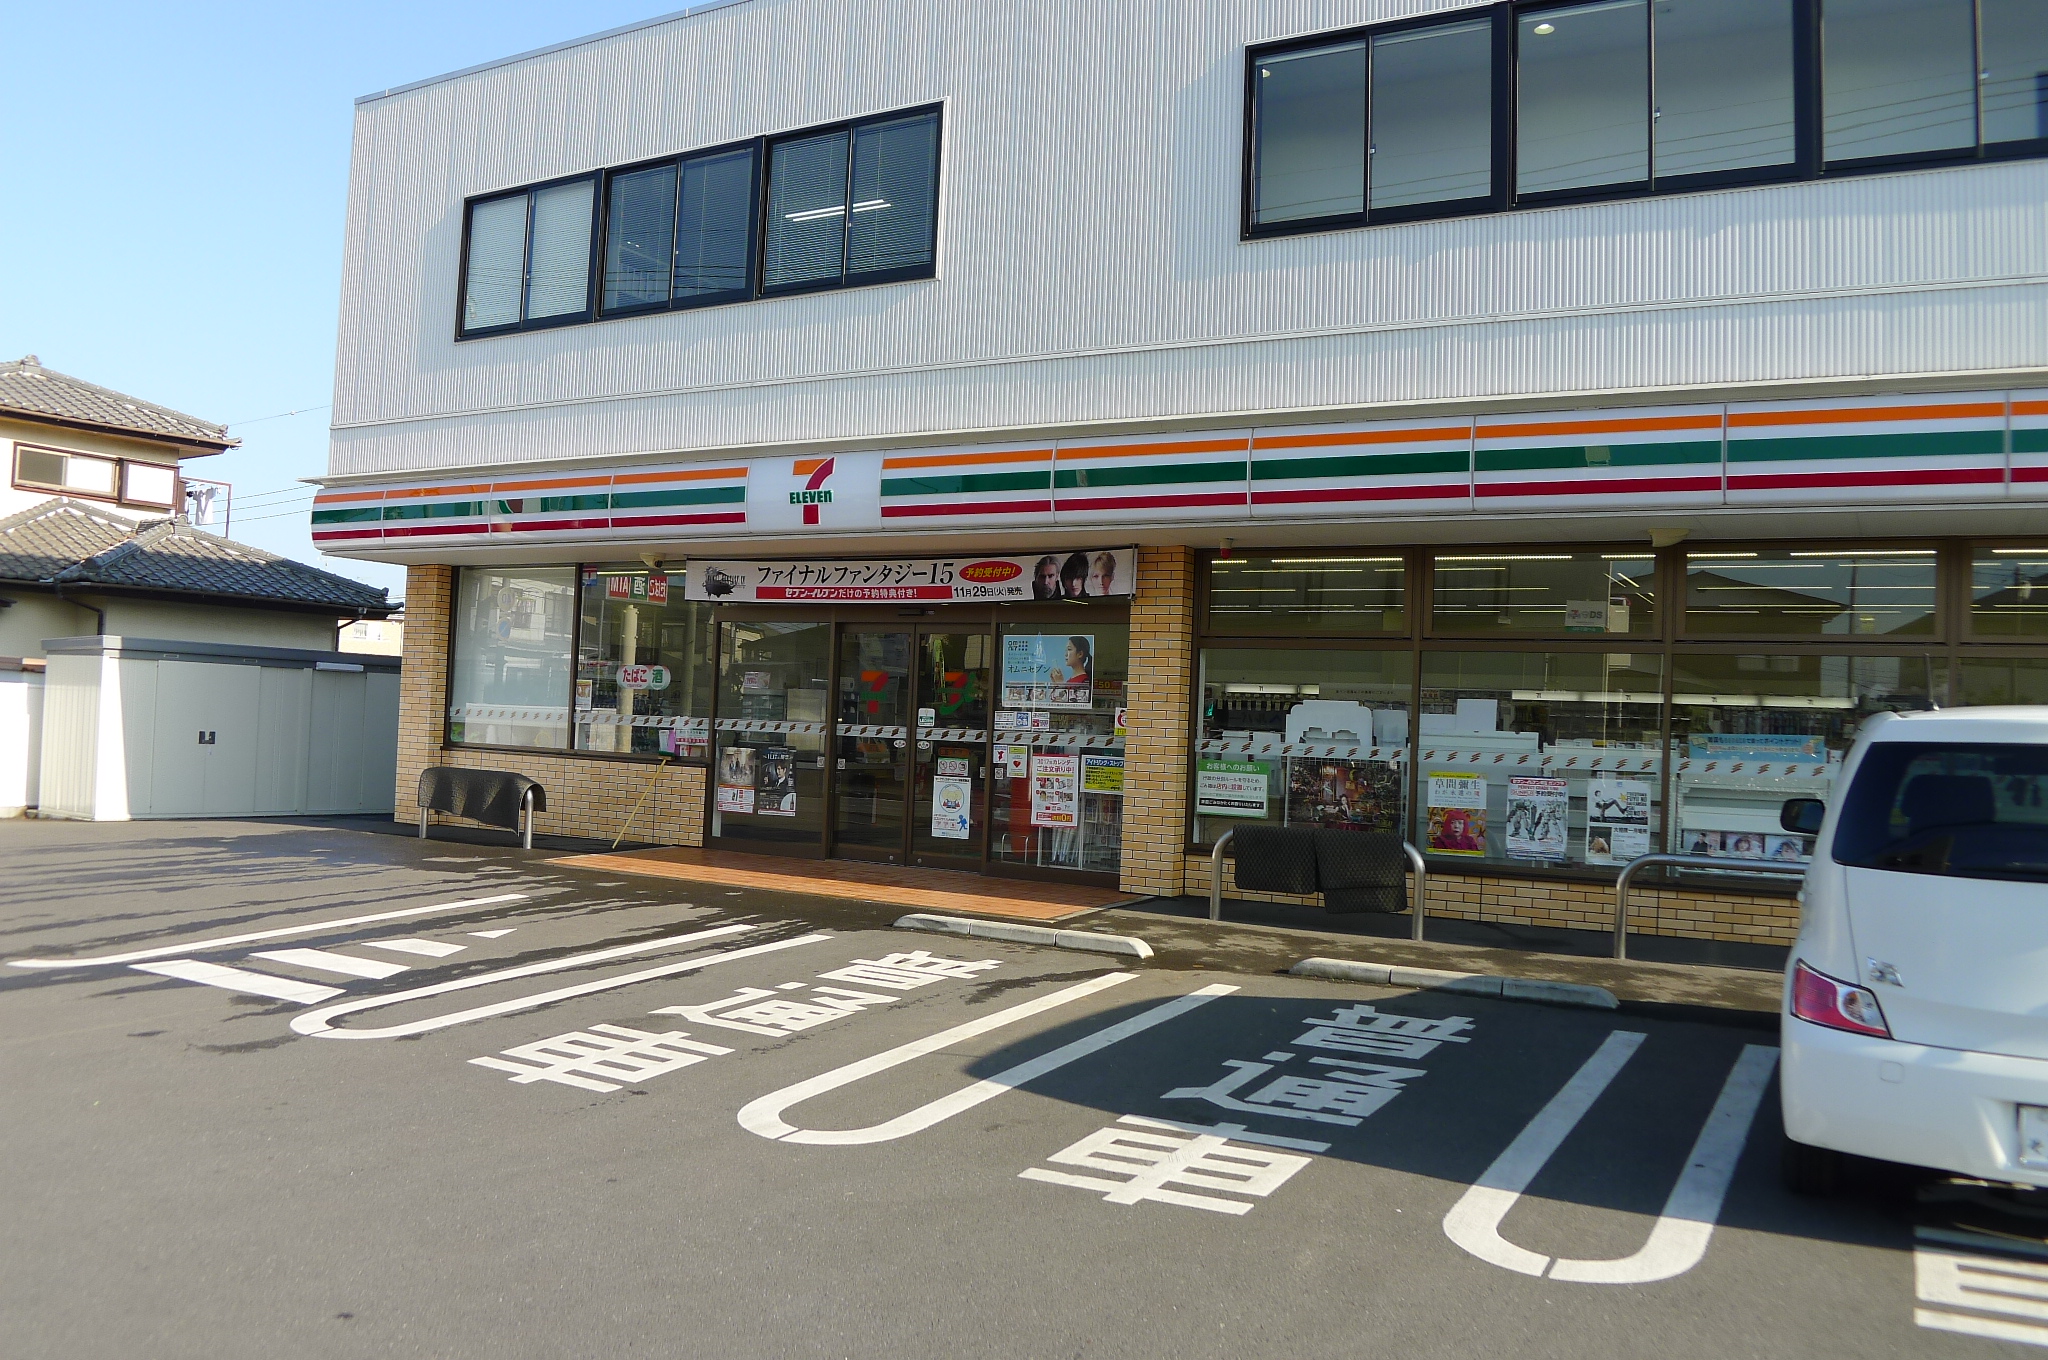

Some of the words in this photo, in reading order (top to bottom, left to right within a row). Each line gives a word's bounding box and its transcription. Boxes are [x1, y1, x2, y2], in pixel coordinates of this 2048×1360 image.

[793, 457, 835, 525] 7
[757, 563, 954, 586] ファイナルファンタジー15
[965, 566, 1016, 577] 予約受付中!
[954, 586, 1023, 598] 11月29日(火)発売
[1008, 665, 1051, 673] オムニセブン
[622, 669, 647, 683] たばこ
[652, 669, 664, 684] 酒
[1086, 758, 1124, 767] アイドリング・ストップ
[1206, 762, 1260, 772] お客様へのお願い
[1435, 778, 1480, 789] 草間彌生
[467, 950, 1003, 1093] 普通車
[1017, 1004, 1476, 1216] 普通車
